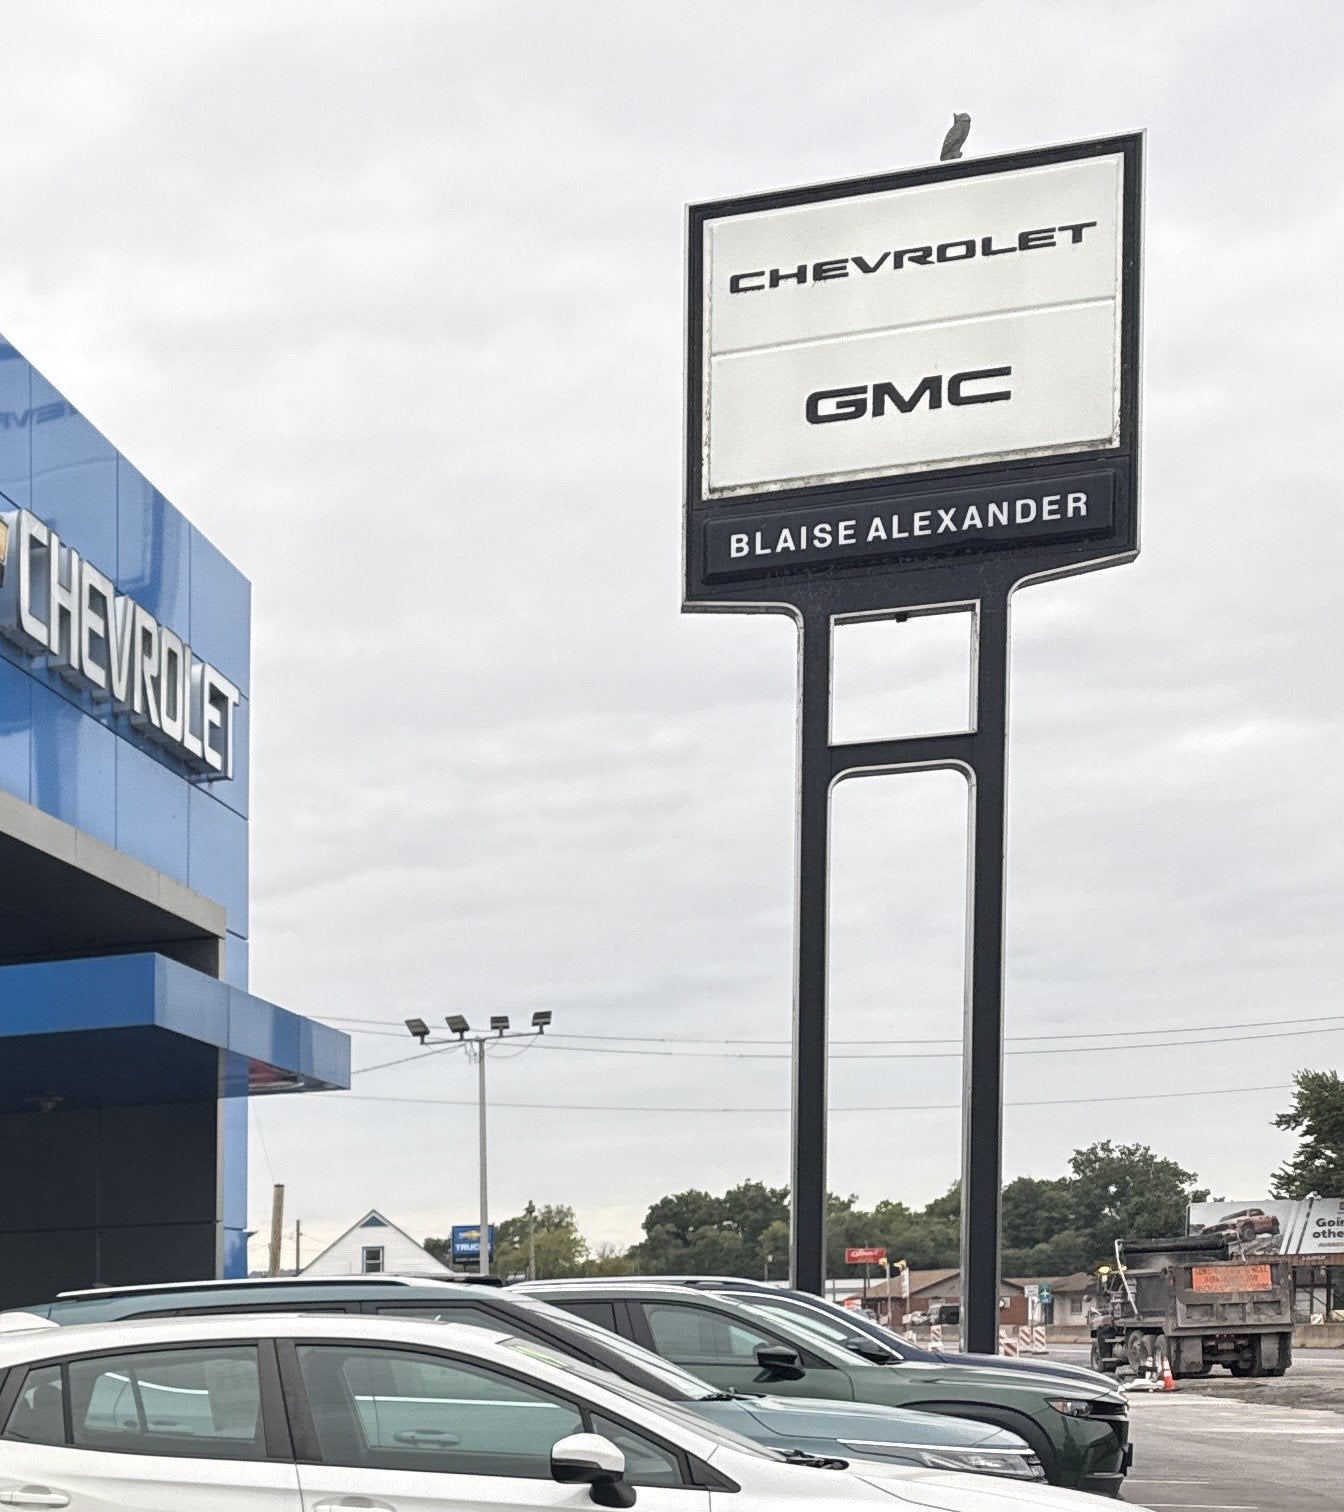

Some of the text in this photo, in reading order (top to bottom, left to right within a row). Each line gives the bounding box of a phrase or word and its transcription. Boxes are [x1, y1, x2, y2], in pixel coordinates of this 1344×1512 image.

[729, 221, 1098, 295] CHEVROLET
[805, 366, 1013, 425] GMC
[730, 492, 1089, 558] BLAISE ALEXANDER
[455, 1243, 491, 1251] TRUC
